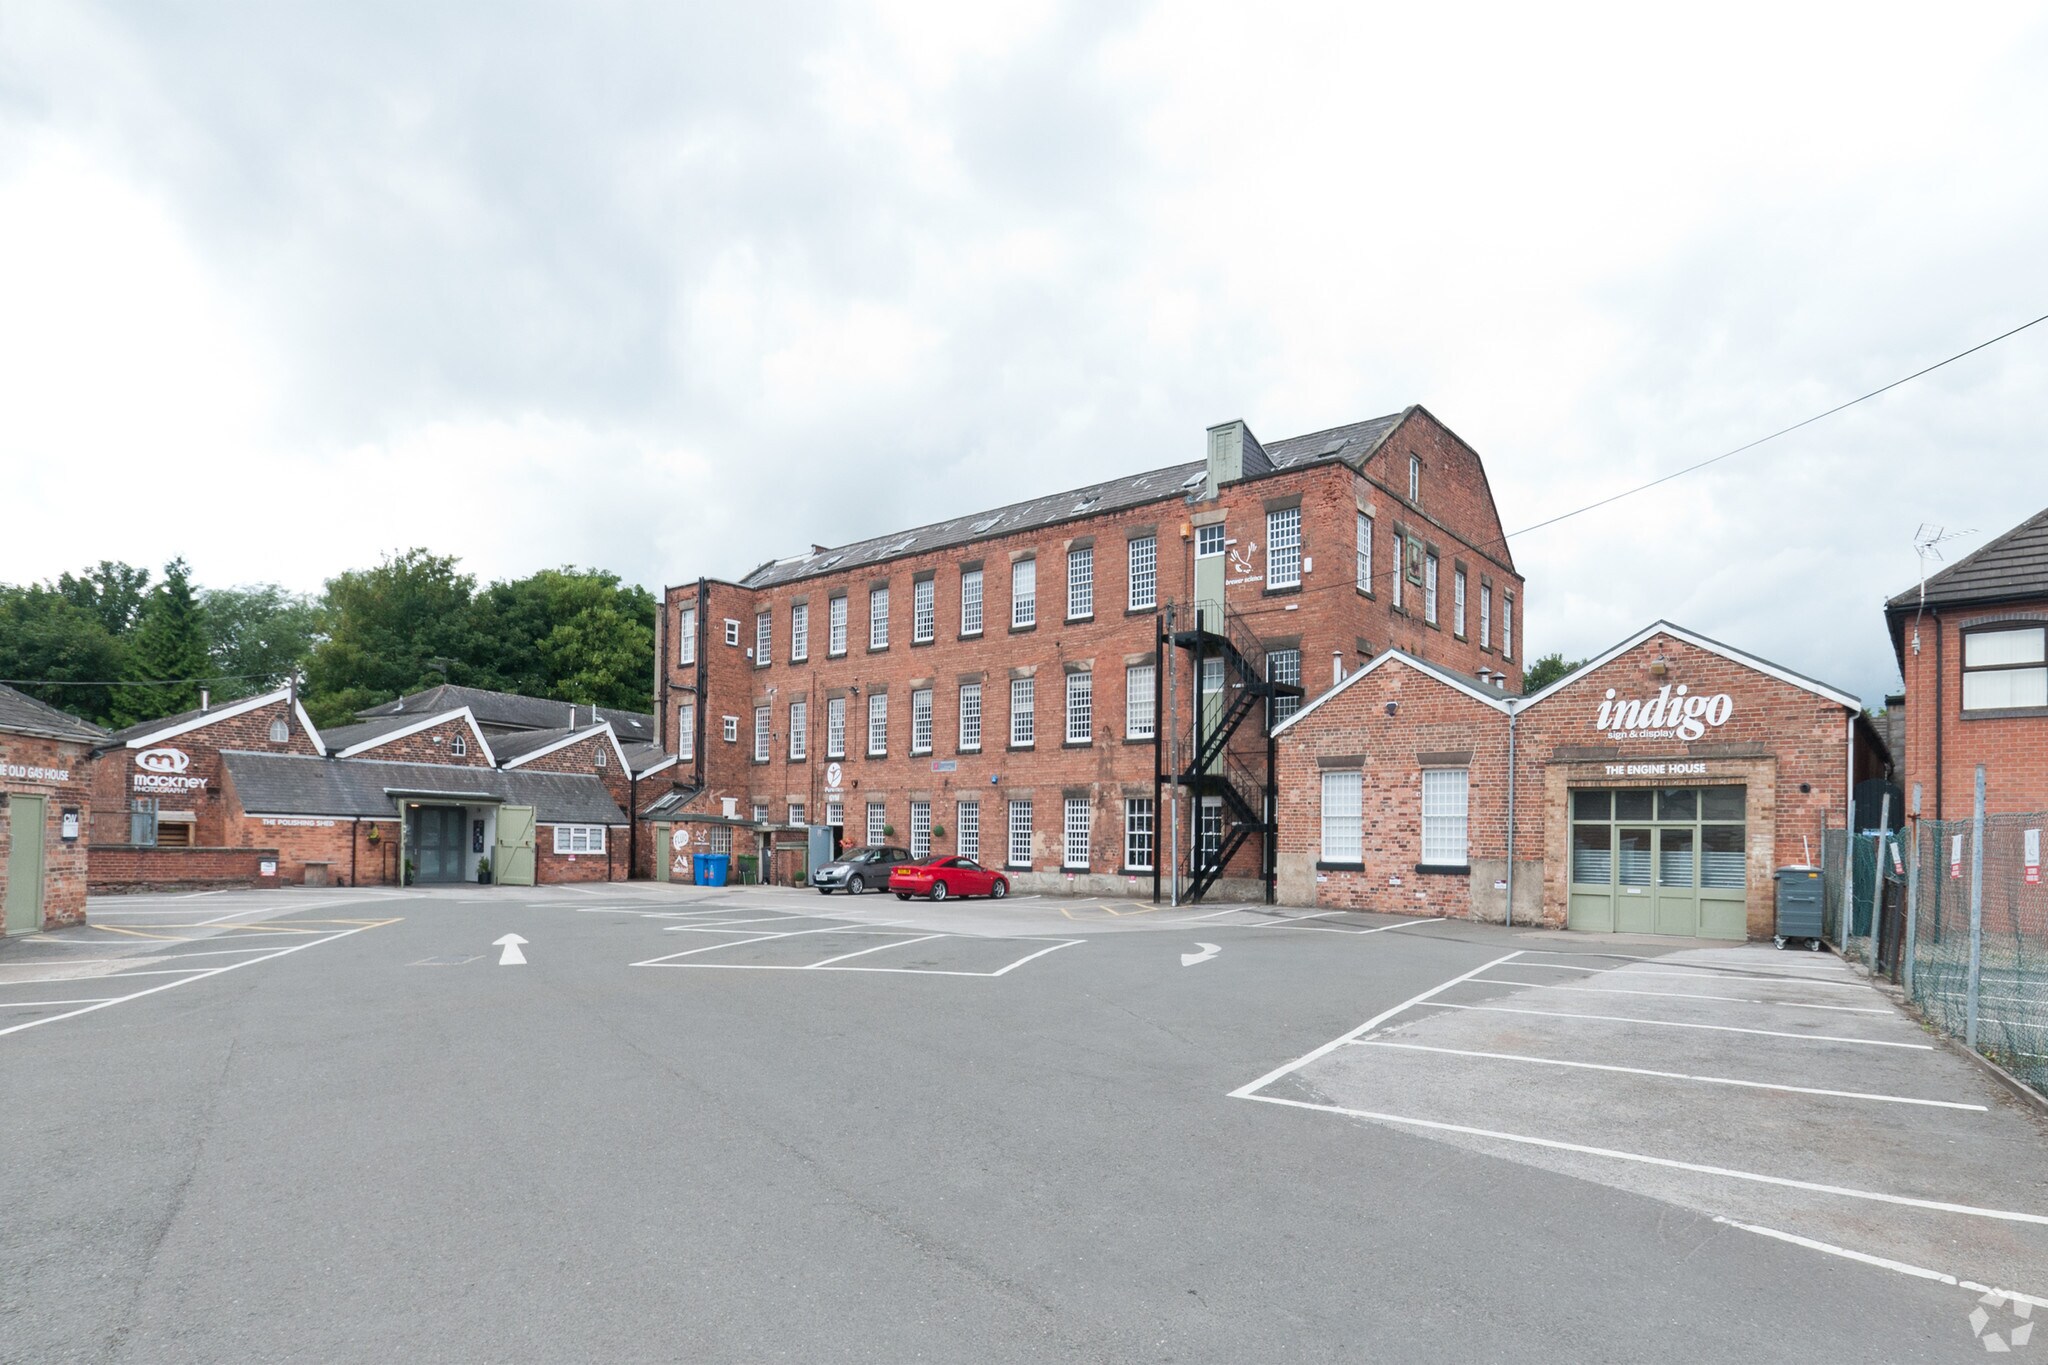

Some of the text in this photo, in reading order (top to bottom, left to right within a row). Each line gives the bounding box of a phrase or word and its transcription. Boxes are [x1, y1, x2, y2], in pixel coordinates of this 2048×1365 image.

[1225, 575, 1263, 586] brewer science
[1596, 684, 1733, 741] indigo
[1607, 729, 1675, 740] sign & display
[8, 765, 26, 777] OLD
[27, 766, 44, 780] GAS
[44, 768, 70, 781] HOUSE
[1605, 763, 1706, 775] THE ENGINE HOUSE
[134, 774, 208, 789] mackney
[134, 785, 188, 794] PHOTOGRAPHY
[262, 818, 276, 826] THE
[277, 819, 315, 827] POLISHING
